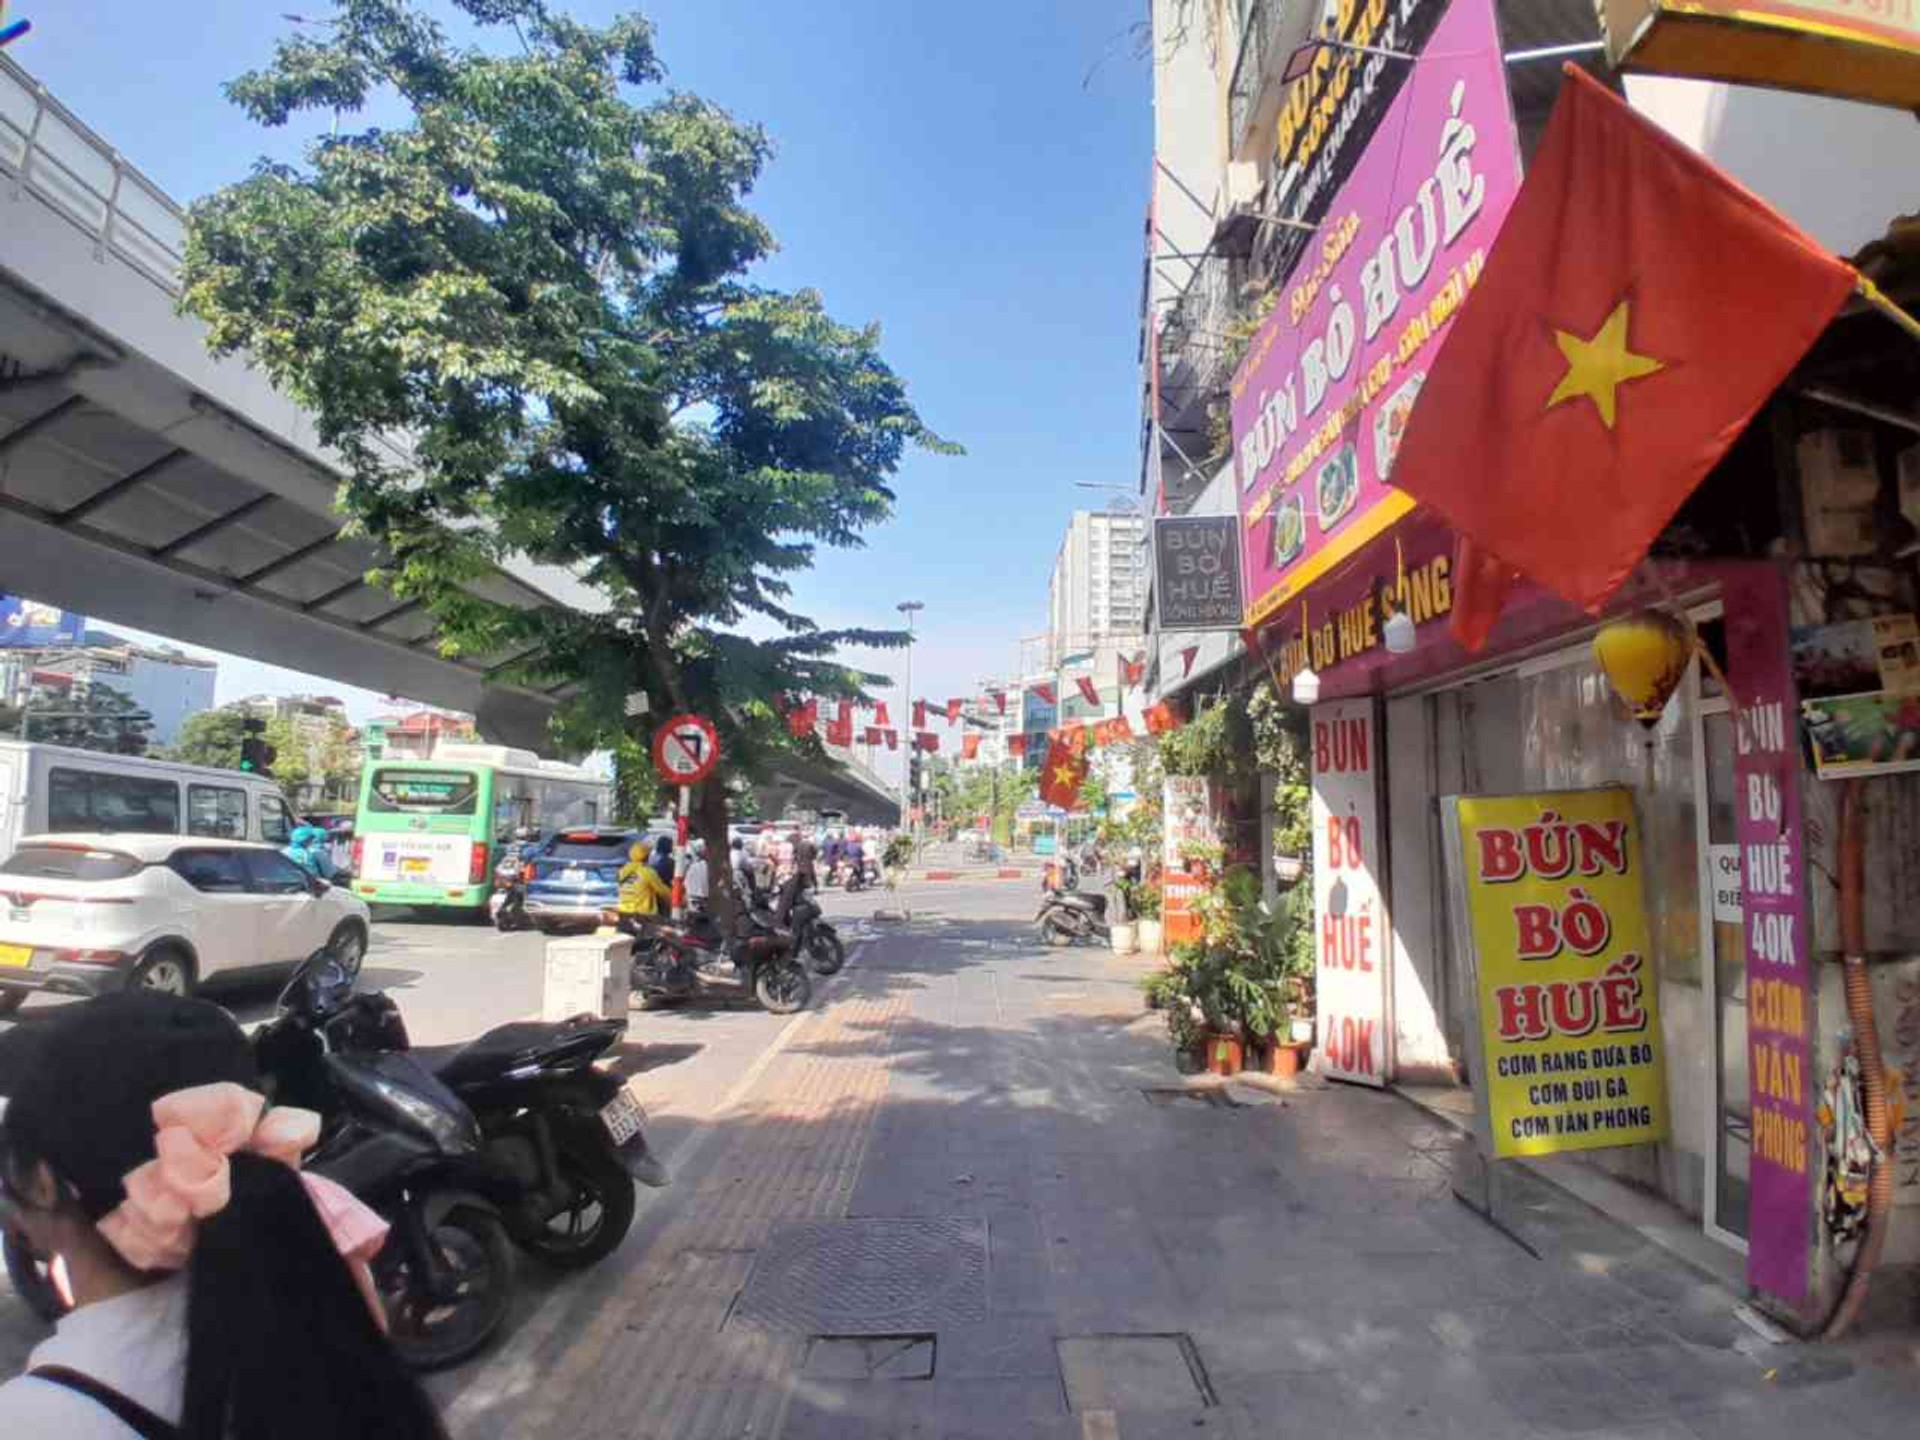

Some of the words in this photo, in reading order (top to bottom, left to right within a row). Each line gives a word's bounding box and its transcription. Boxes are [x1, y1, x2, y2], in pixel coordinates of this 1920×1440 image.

[1240, 371, 1297, 496] BÚN
[1301, 282, 1356, 418] BÒ
[1359, 78, 1486, 343] HUẾ
[1315, 708, 1369, 775] BÚN
[1327, 801, 1363, 872] BÒ
[1476, 811, 1630, 883] BÚN
[1747, 827, 1793, 895] HUẾ
[1322, 895, 1375, 973] HUẾ
[1513, 886, 1611, 960] BÒ
[1752, 912, 1796, 966] 40K
[1495, 953, 1648, 1041] HUẾ
[1326, 1013, 1375, 1078] 40K
[1541, 1048, 1588, 1073] RANG
